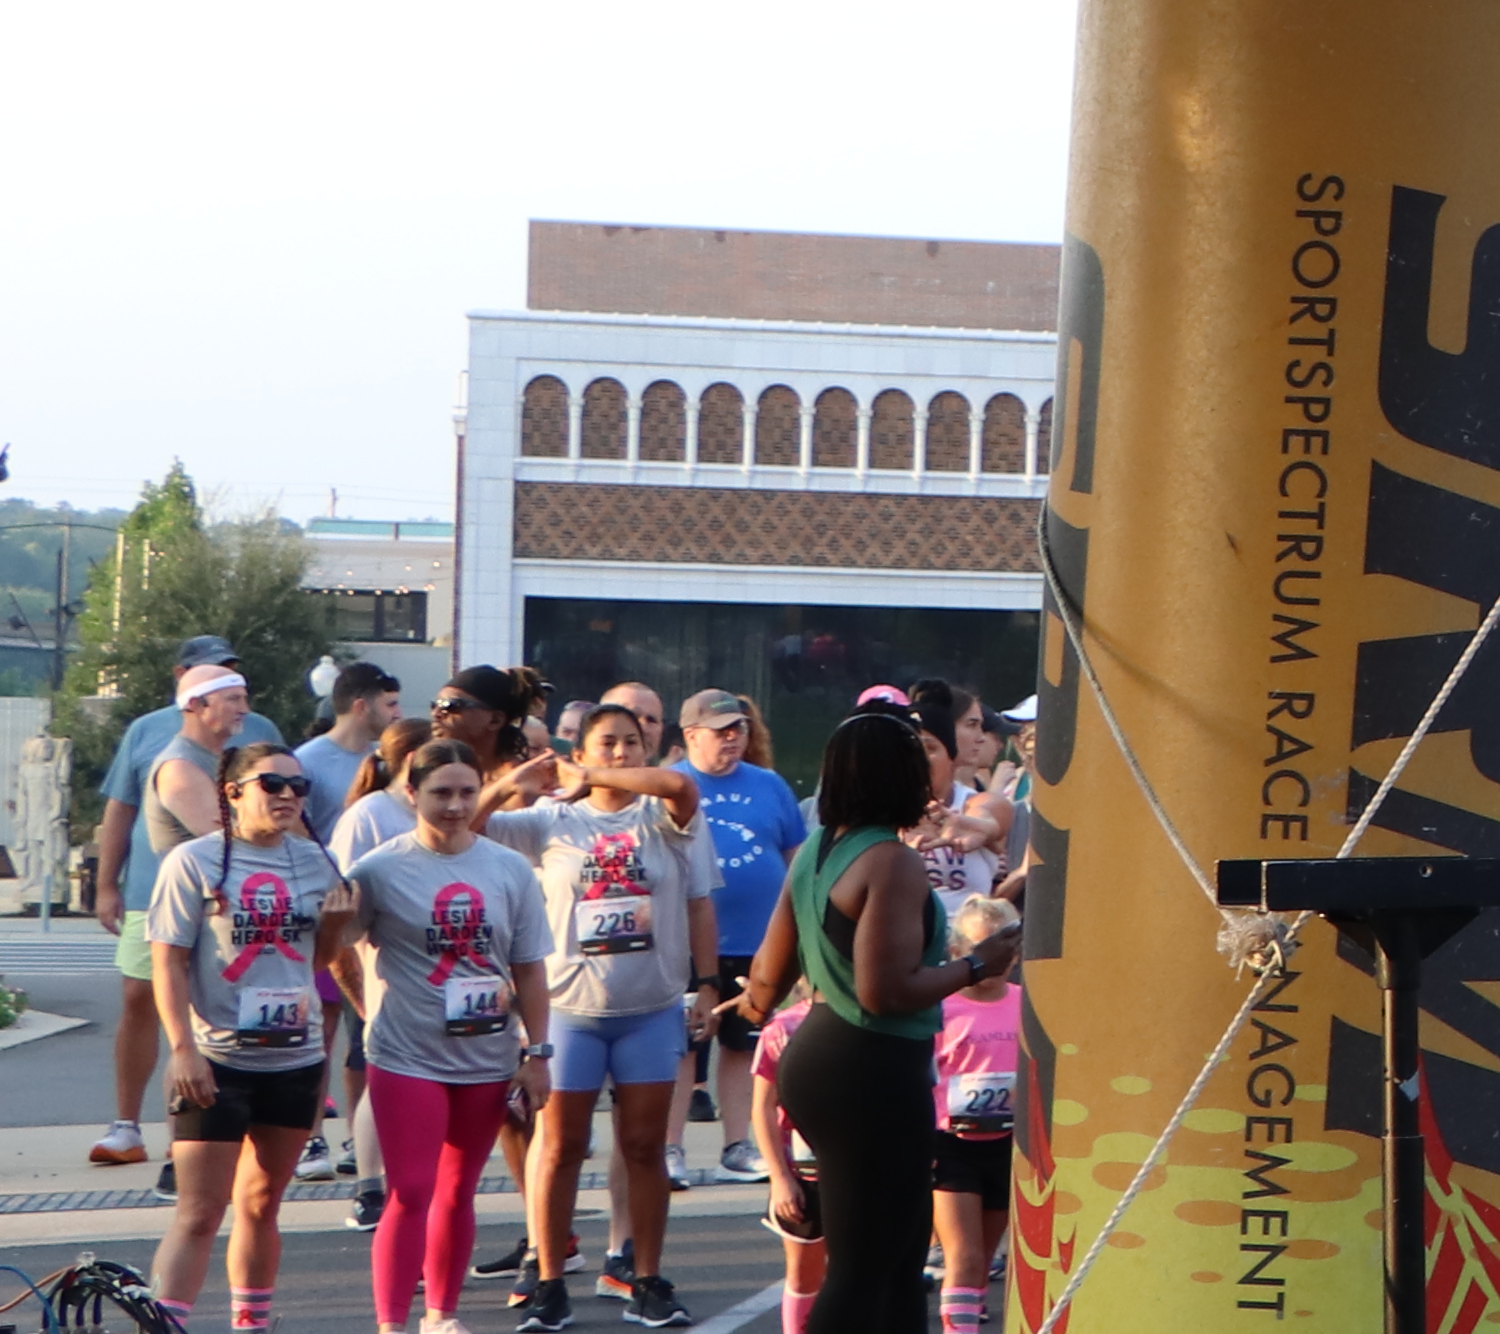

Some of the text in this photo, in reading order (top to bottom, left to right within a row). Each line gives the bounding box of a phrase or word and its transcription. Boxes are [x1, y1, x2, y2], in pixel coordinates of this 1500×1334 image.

[1236, 172, 1346, 1322] SPORTSPECTRUM RACE NAGEMENT
[716, 845, 763, 867] RONG
[430, 908, 487, 925] LESLIE
[593, 911, 636, 937] 226
[231, 928, 302, 945] HERO 5K
[426, 925, 494, 943] DARDEN
[258, 1003, 299, 1027] 143
[463, 992, 499, 1016] 144
[965, 1088, 1011, 1113] 222
